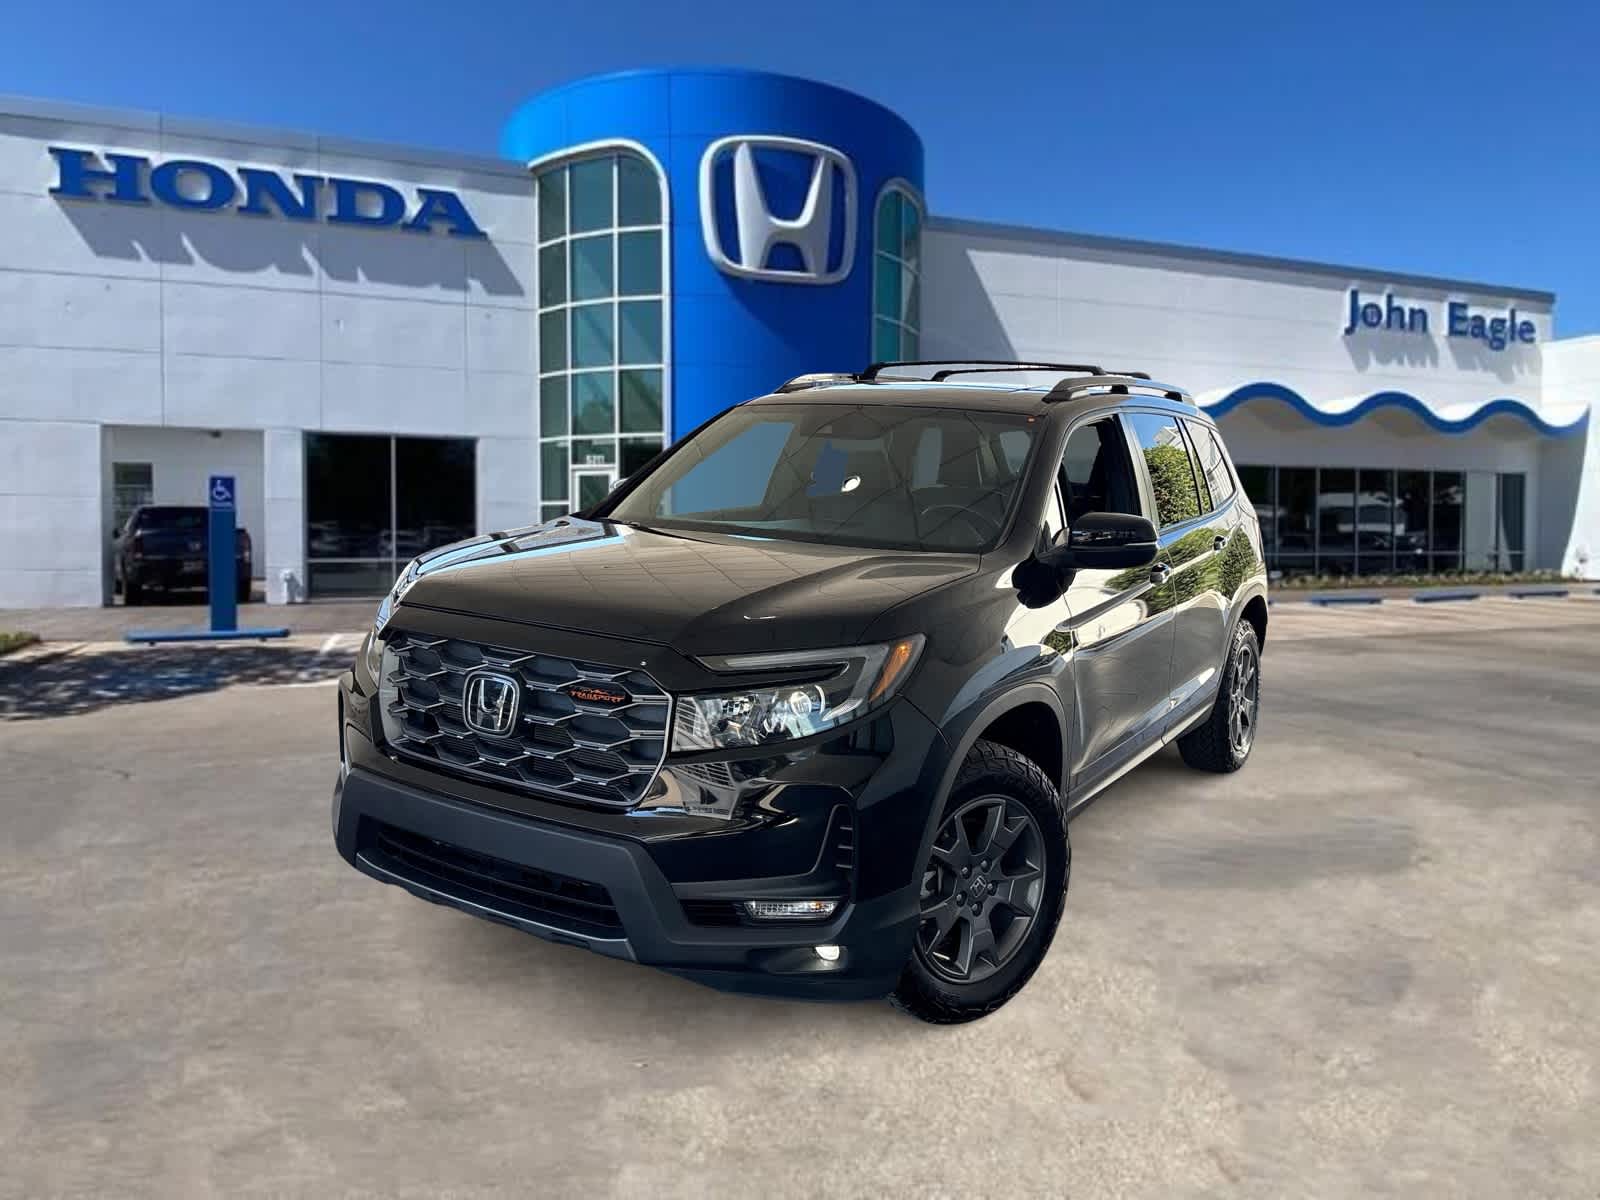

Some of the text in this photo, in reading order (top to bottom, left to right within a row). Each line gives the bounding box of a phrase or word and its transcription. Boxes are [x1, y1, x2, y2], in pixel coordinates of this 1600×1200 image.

[48, 146, 487, 240] HONDA
[1344, 289, 1536, 351] John Eagle
